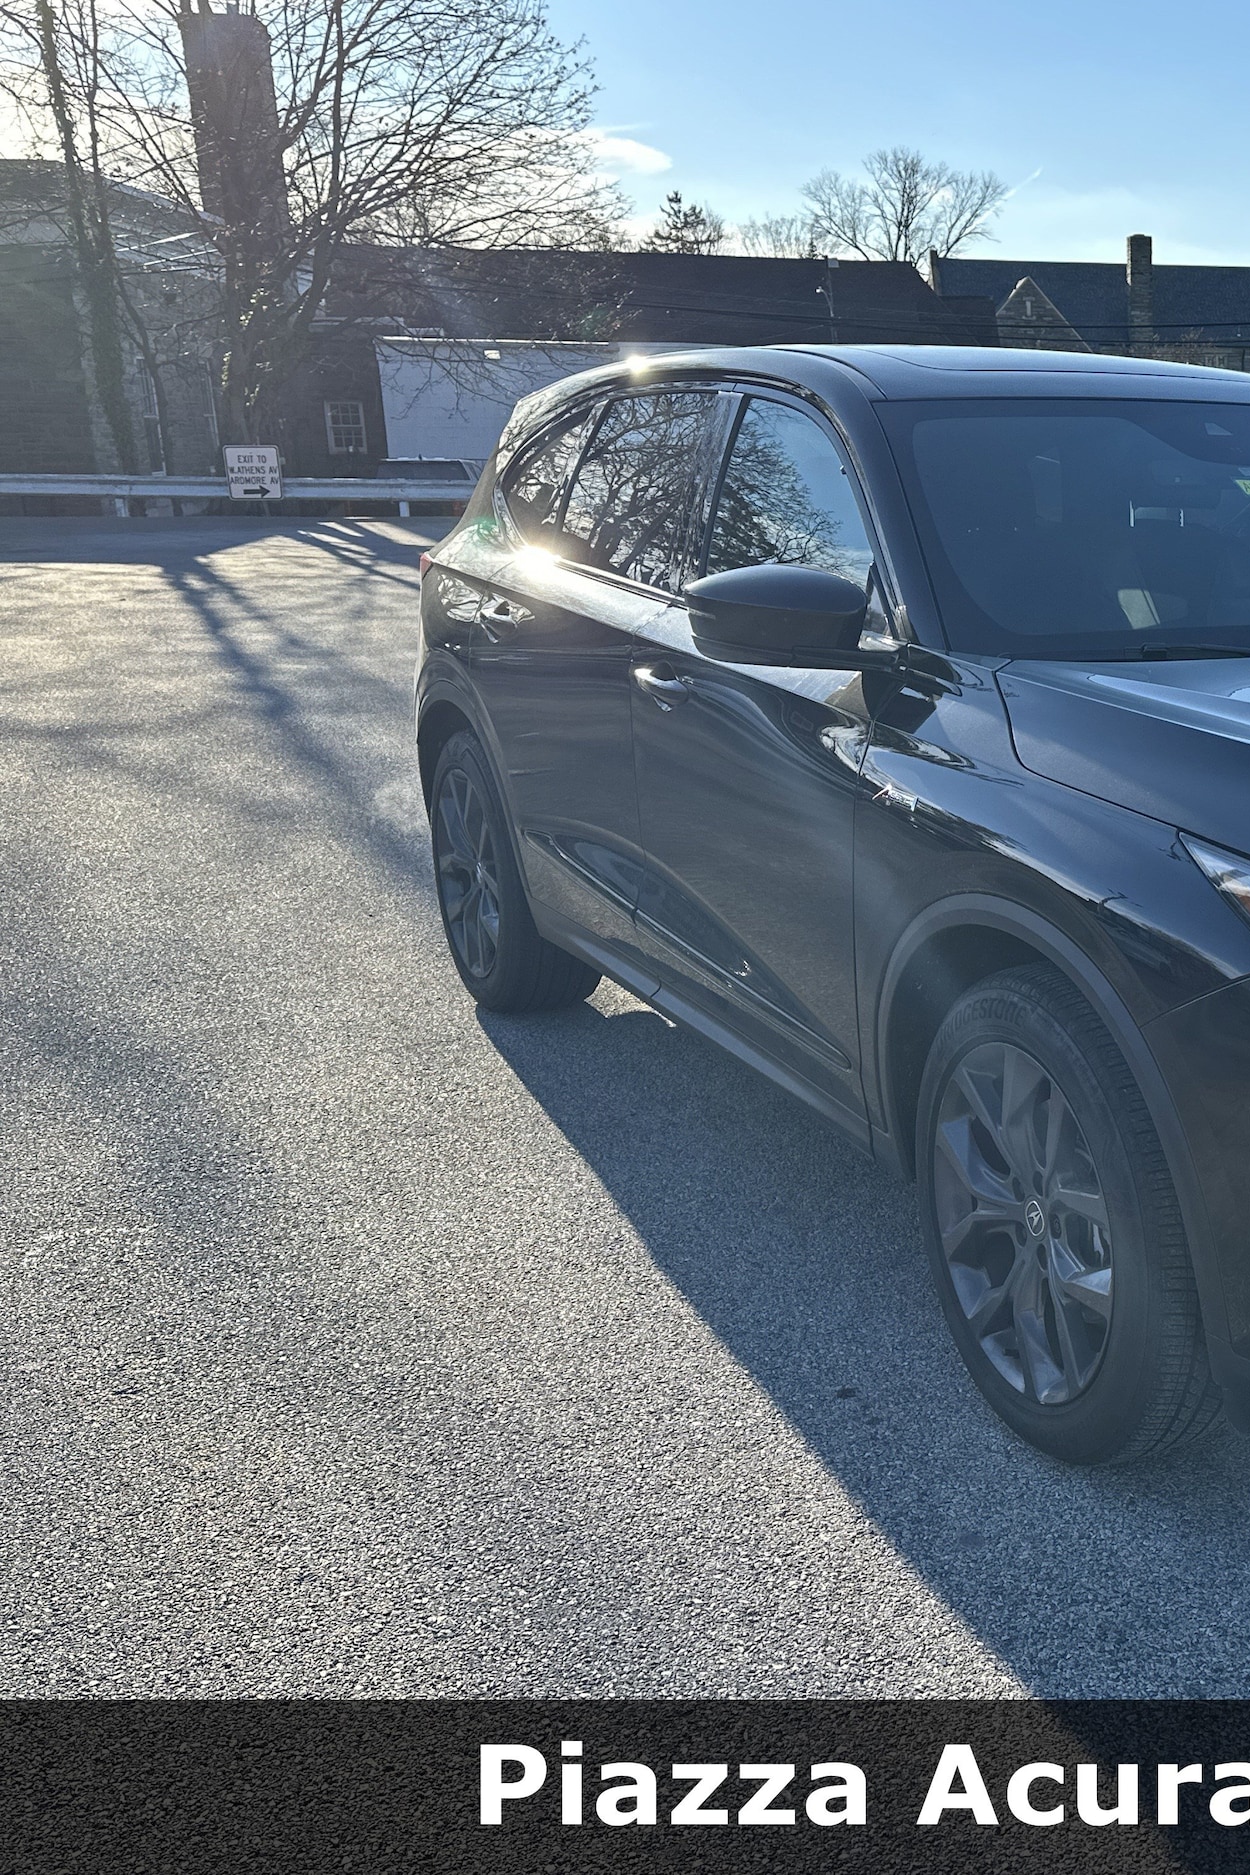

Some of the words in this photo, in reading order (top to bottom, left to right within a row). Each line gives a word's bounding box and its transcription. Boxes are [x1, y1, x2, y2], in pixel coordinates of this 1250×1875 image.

[237, 454, 253, 464] EXIT
[256, 454, 267, 464] TO
[268, 466, 279, 475] AV
[230, 476, 267, 485] ARDMORE
[270, 476, 279, 485] AV
